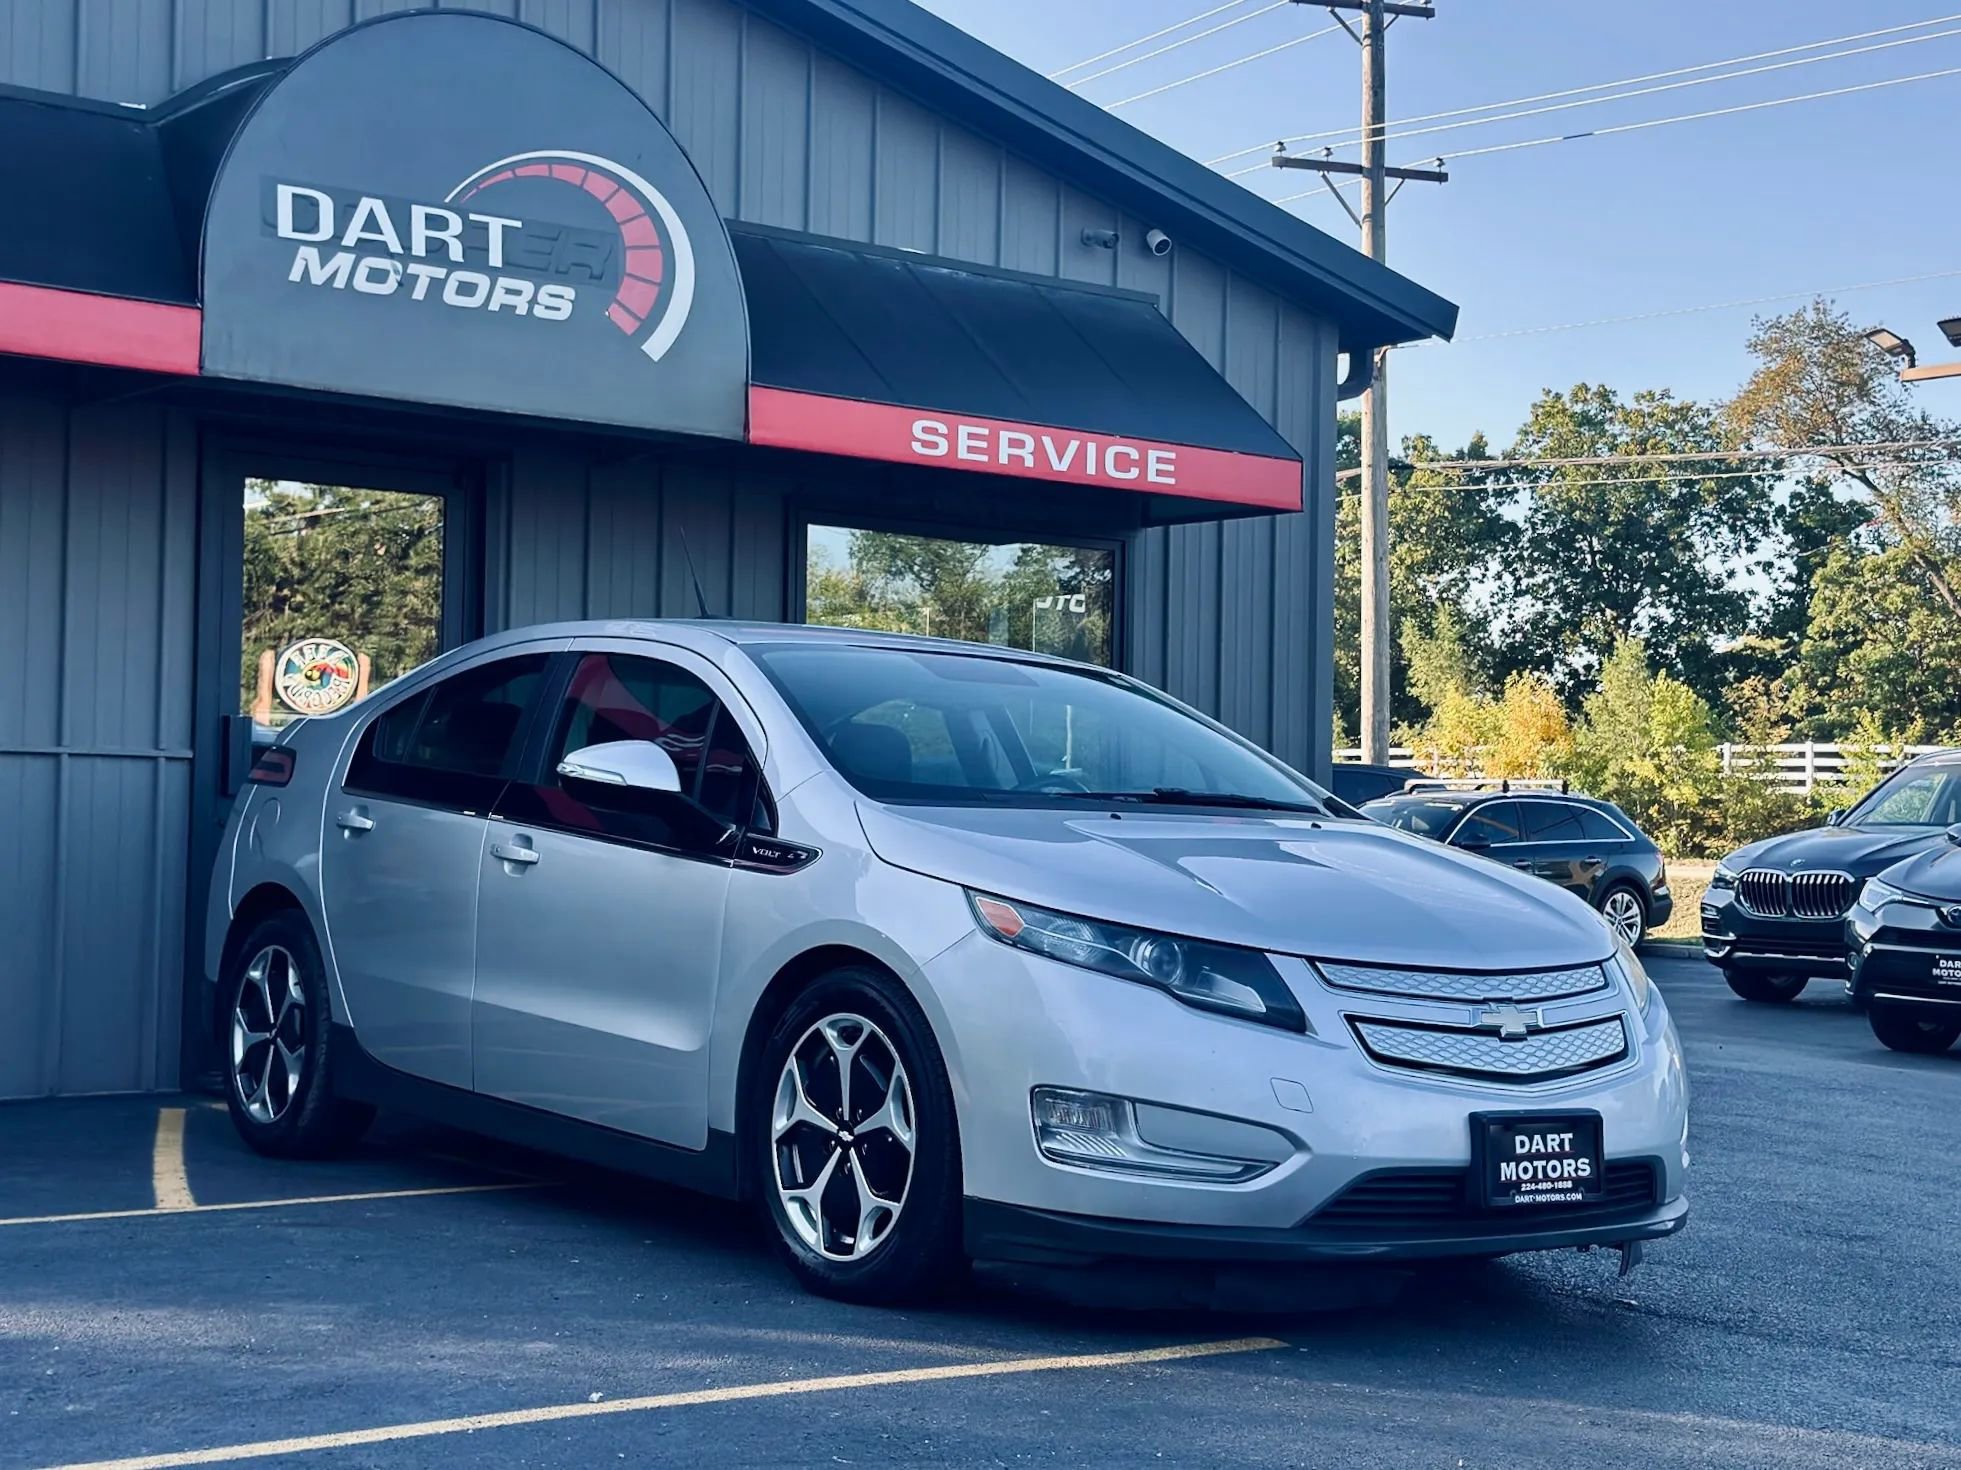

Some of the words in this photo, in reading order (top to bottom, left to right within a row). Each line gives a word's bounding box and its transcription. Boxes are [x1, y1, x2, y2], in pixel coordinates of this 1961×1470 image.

[276, 184, 522, 267] DART
[288, 245, 577, 321] MOTORS
[911, 419, 1177, 485] SERVICE
[752, 846, 781, 858] VOLT
[1514, 1132, 1574, 1154] DART
[1500, 1157, 1591, 1181] MOTORS
